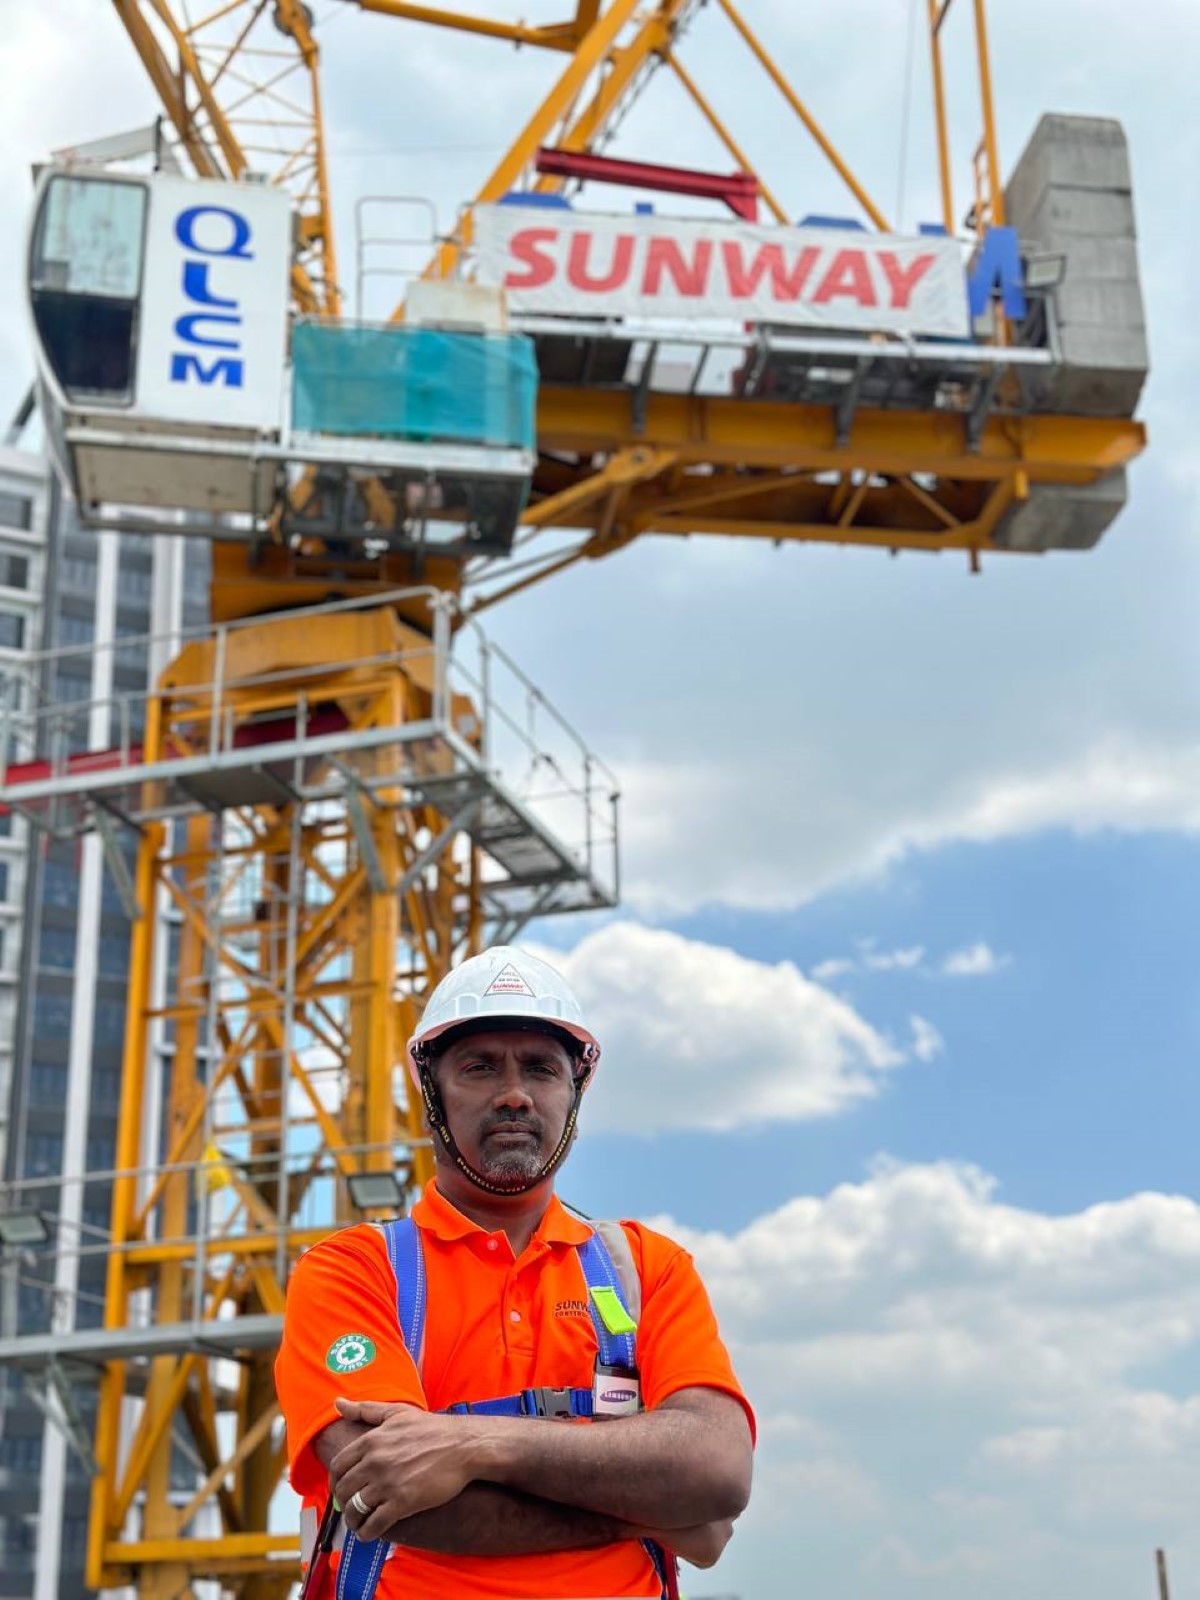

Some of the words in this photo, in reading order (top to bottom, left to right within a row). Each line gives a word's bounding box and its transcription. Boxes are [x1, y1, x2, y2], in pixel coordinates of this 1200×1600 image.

[171, 205, 253, 388] QLCM
[503, 226, 937, 309] SUNWAY
[330, 1335, 369, 1355] SAFETY
